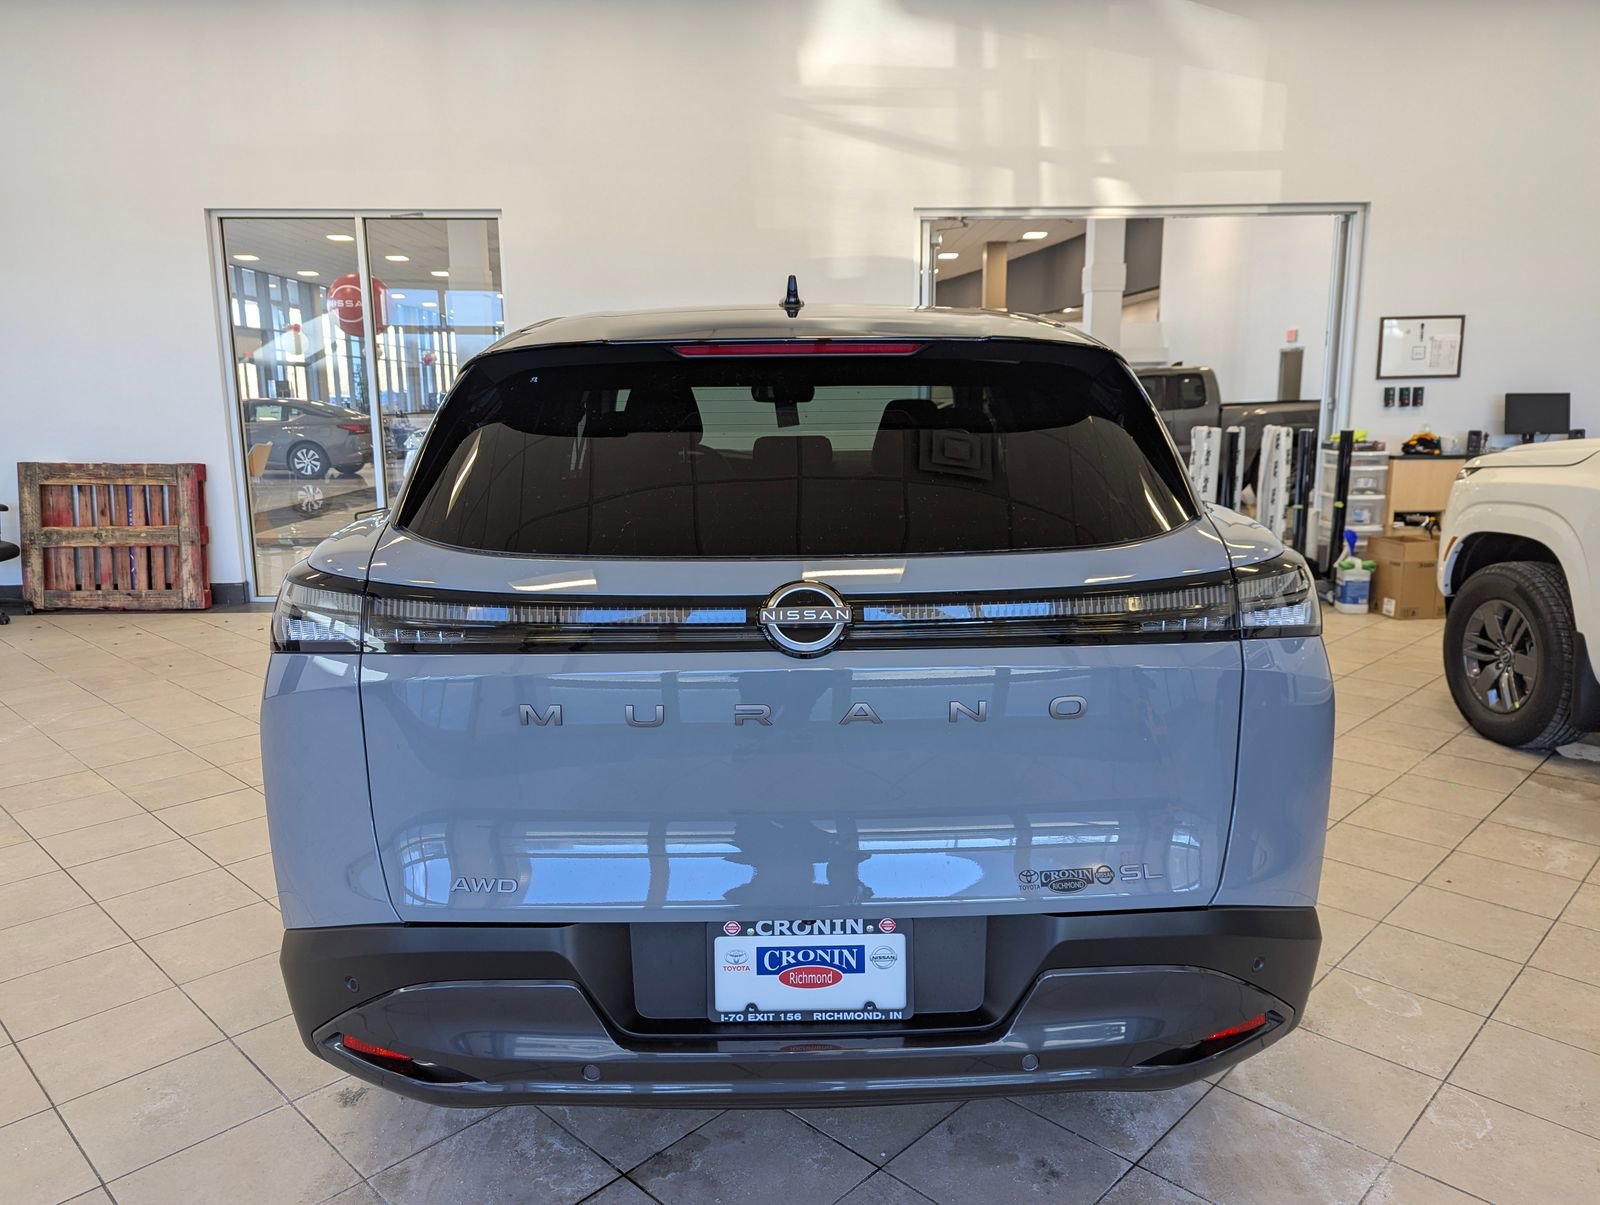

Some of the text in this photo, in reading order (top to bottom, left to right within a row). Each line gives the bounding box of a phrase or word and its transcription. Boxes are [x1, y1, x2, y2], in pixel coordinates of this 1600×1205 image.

[326, 299, 363, 308] ISSA
[762, 609, 849, 621] NISSAN
[518, 694, 1089, 728] MURANO
[1041, 868, 1093, 884] CRONIN
[1120, 863, 1163, 881] SL
[450, 877, 518, 893] AWD
[755, 918, 864, 936] CRONIN
[764, 948, 858, 971] CRONIN
[789, 971, 833, 985] Richmond
[720, 1011, 903, 1022] I-70 EXIT 156 RICHMOND, IN
